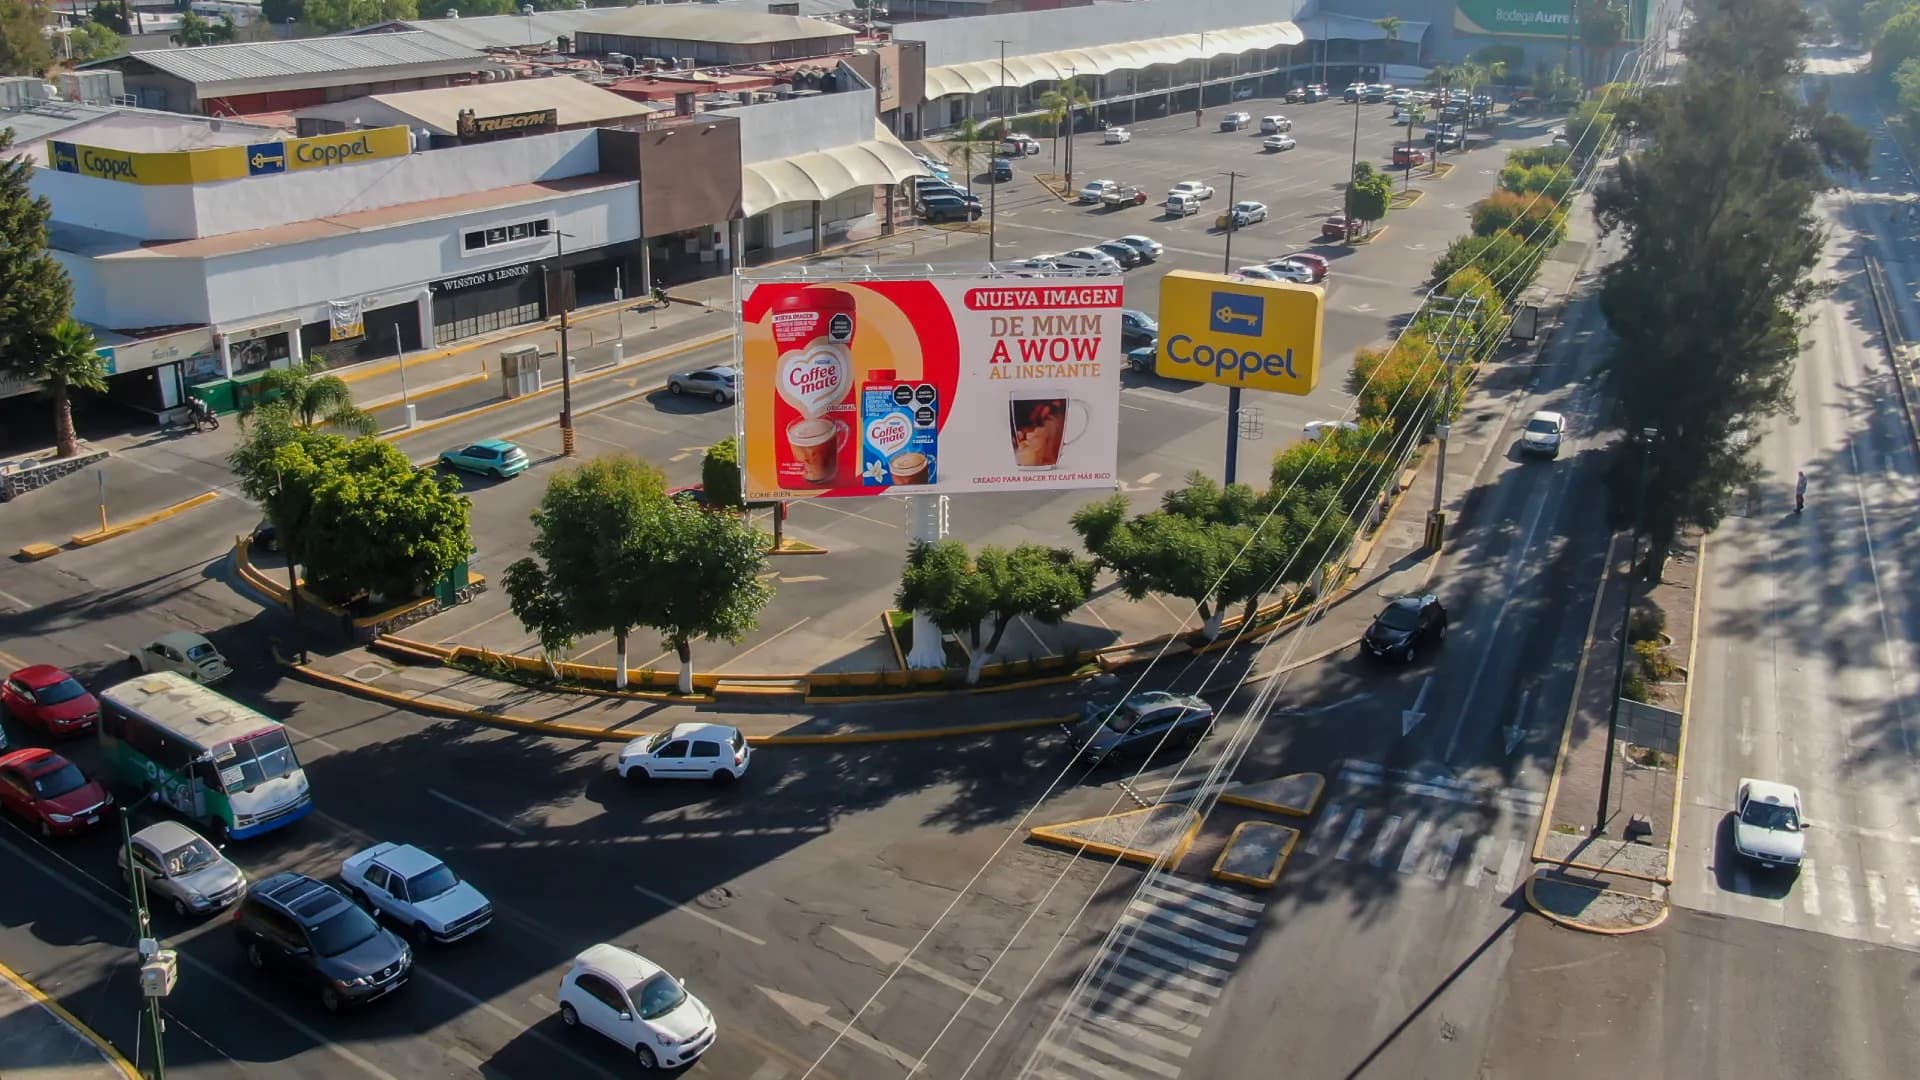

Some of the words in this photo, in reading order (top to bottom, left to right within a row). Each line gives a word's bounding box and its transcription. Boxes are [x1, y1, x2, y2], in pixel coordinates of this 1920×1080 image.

[1496, 7, 1534, 25] Bodega
[1535, 10, 1579, 24] Aurrea
[297, 135, 374, 165] Coppel
[84, 150, 137, 179] Coppel
[443, 274, 486, 291] WINSTON
[487, 273, 495, 282] &
[496, 265, 529, 280] LENNON
[975, 291, 1038, 307] NUEVA
[1043, 289, 1117, 305] IMAGEN
[990, 316, 1024, 337] DE
[1032, 315, 1102, 335] MMM
[989, 339, 1012, 364] A
[1017, 337, 1101, 362] WOW
[1167, 334, 1297, 381] Coppel
[790, 365, 836, 386] Coffee
[990, 367, 1012, 379] AL
[1015, 364, 1101, 379] INSTANTE
[801, 376, 838, 395] mate
[872, 425, 904, 440] Coffee
[880, 434, 905, 446] mate
[1002, 476, 1021, 484] PARA
